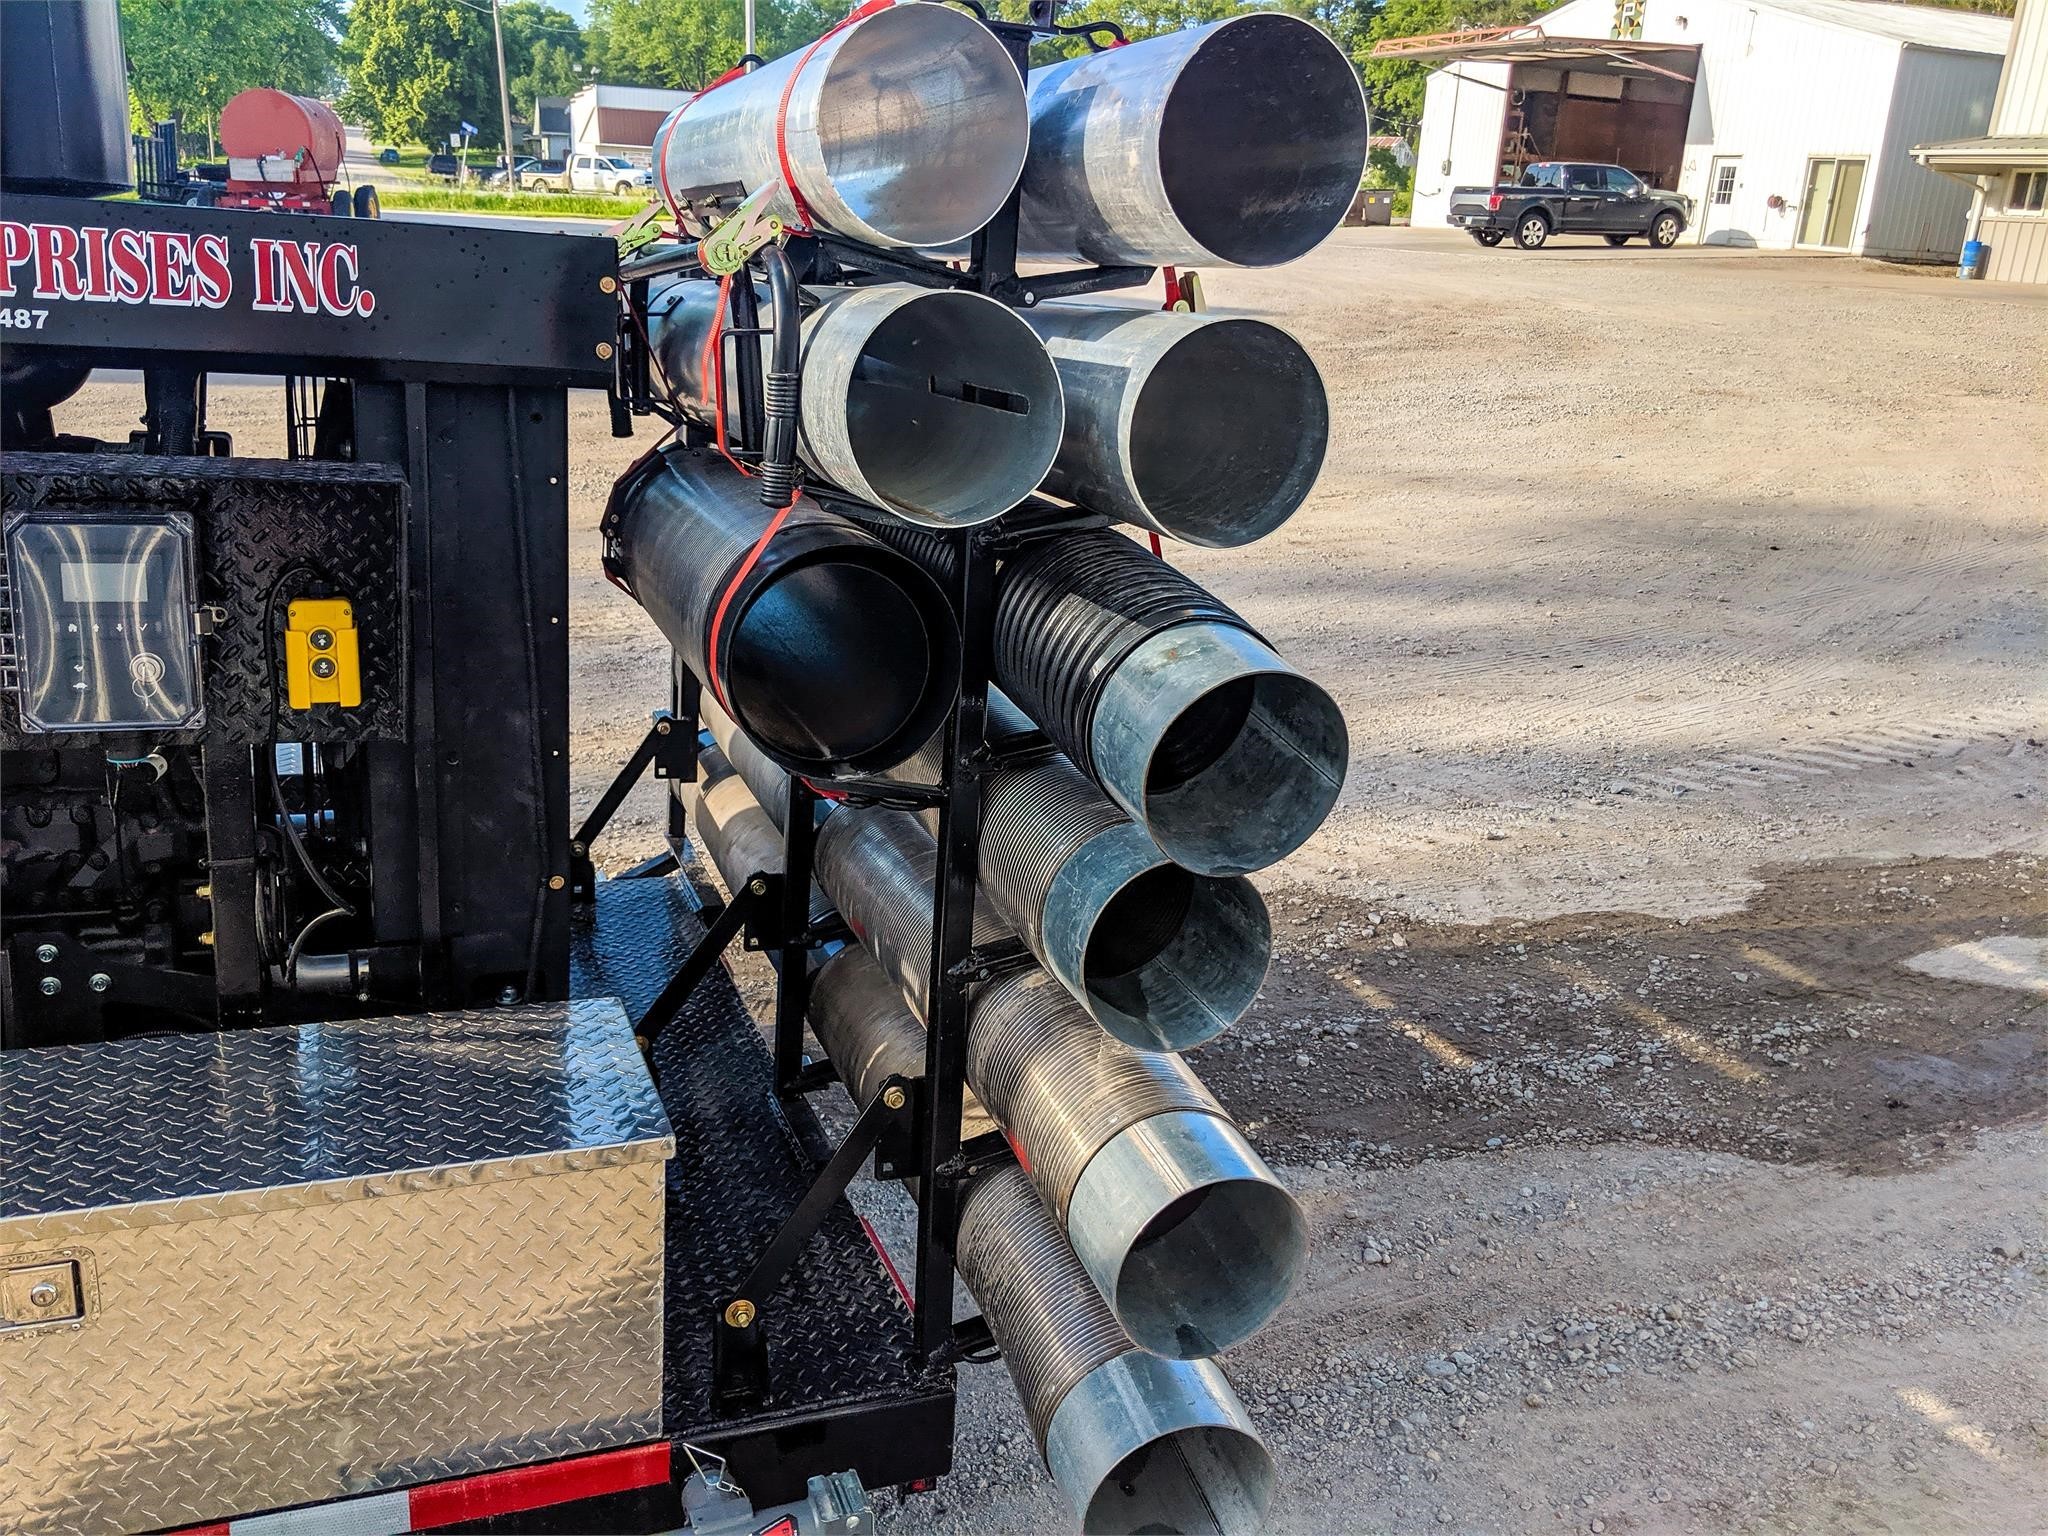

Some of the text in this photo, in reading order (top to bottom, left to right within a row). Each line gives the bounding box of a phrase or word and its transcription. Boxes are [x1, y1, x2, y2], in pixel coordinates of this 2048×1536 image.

[0, 221, 375, 318] PRISES INC.
[0, 308, 49, 329] 487
